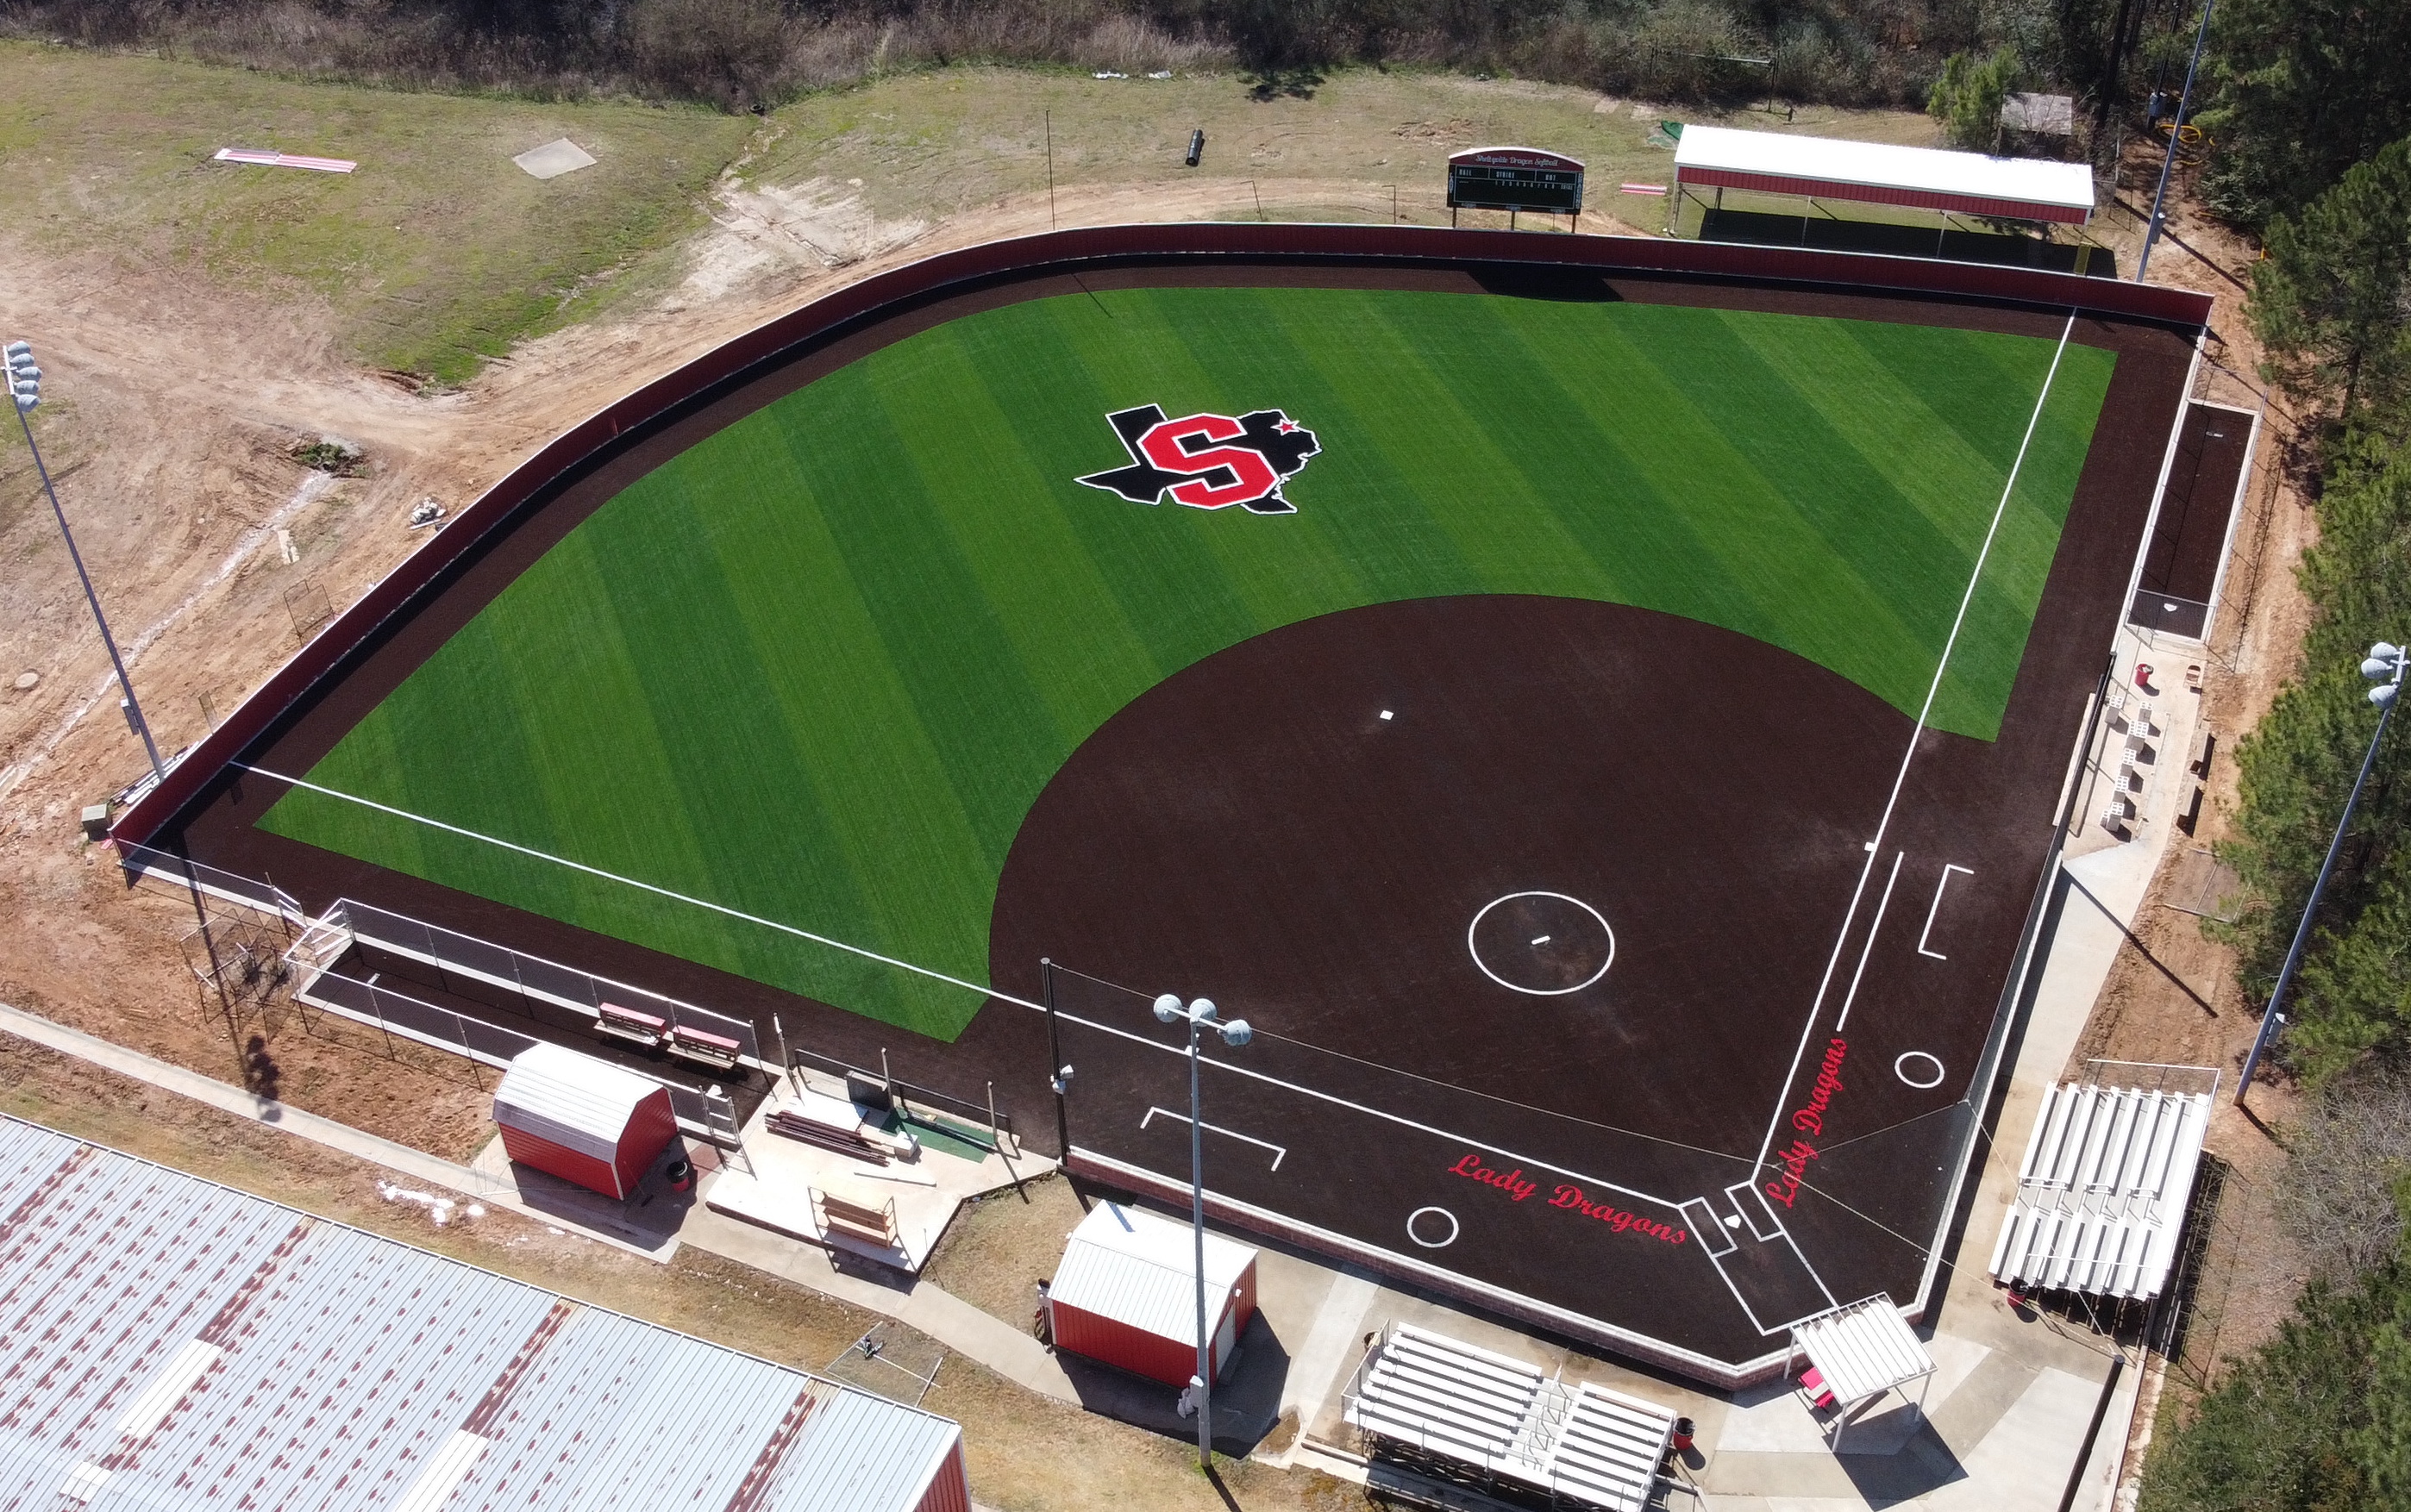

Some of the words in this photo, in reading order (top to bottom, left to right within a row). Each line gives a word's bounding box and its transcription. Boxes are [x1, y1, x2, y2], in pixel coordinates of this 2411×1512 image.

[1510, 157, 1533, 166] Dragon
[1137, 413, 1281, 510] S
[1792, 1038, 1847, 1136] Dragons
[1449, 1155, 1537, 1202] Lady
[1549, 1184, 1686, 1244] Dragons
[1766, 1140, 1819, 1209] Lady
